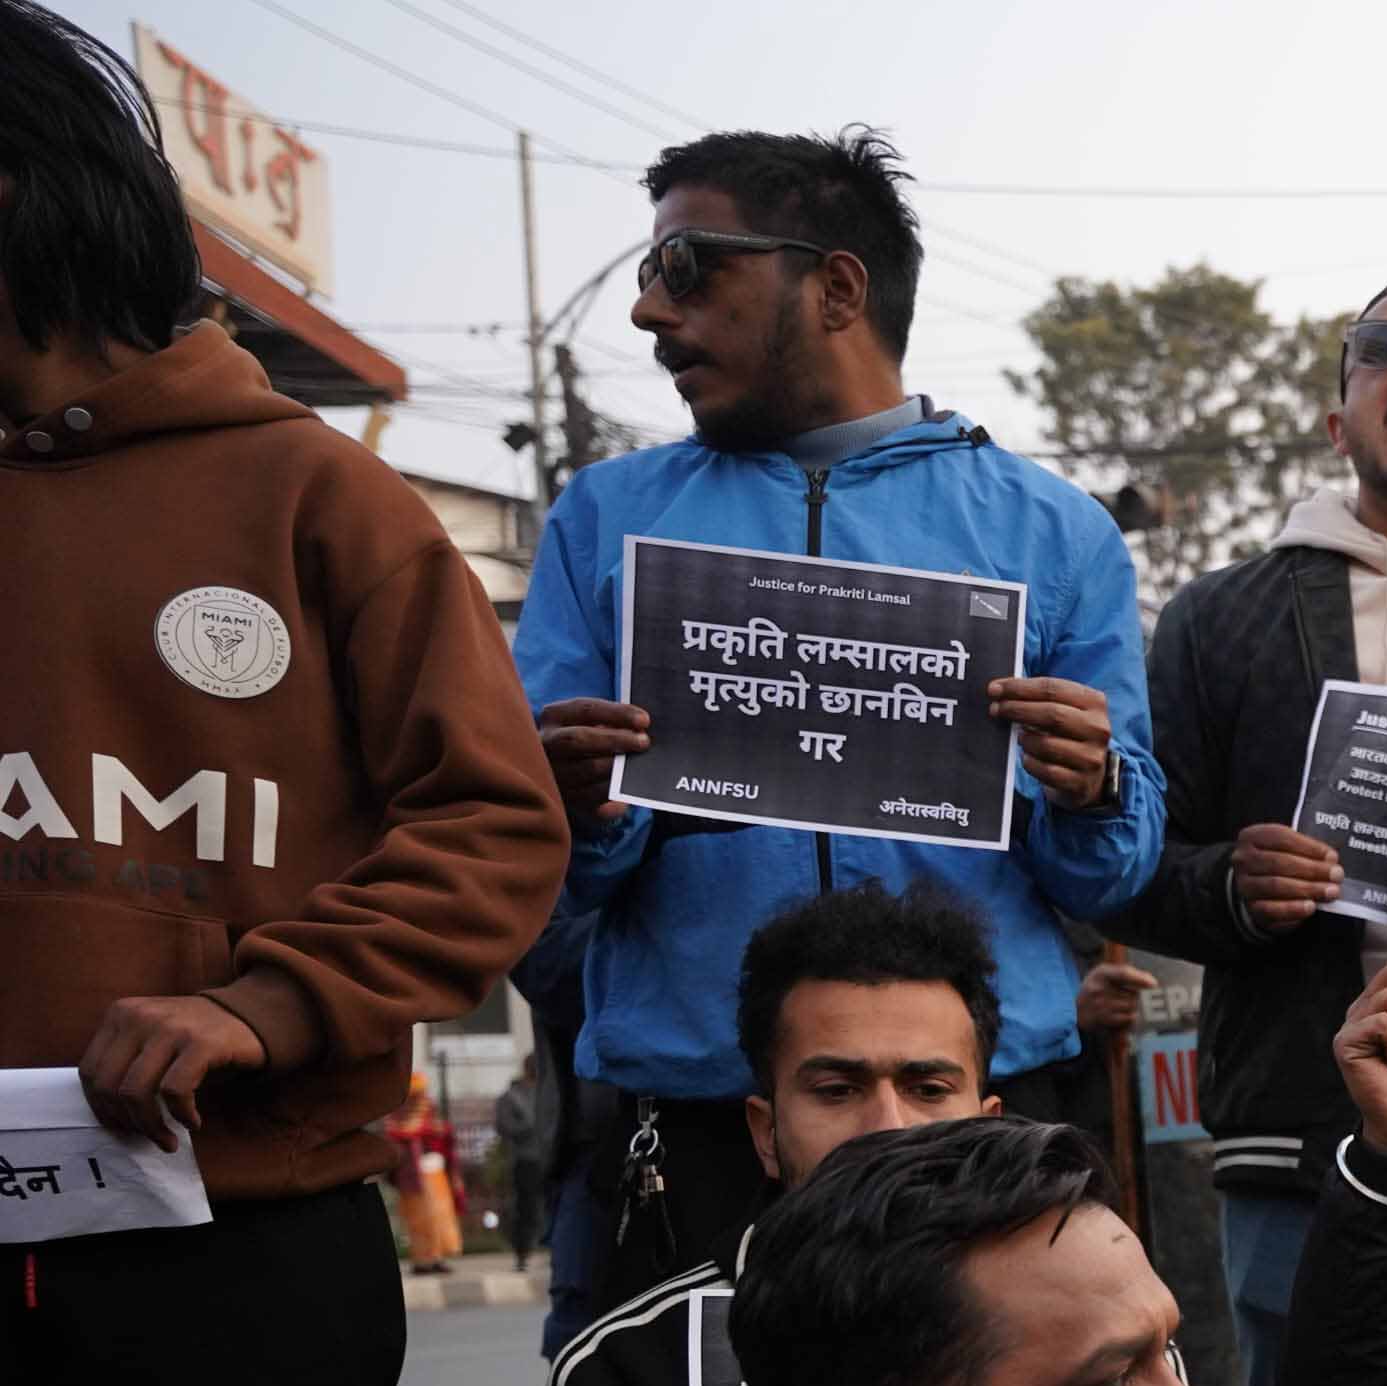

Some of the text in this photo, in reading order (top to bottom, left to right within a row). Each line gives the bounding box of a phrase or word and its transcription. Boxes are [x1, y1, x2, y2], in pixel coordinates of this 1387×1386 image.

[749, 576, 911, 605] Justice for Prakriti Lamsal
[202, 612, 253, 627] MIAMI
[681, 617, 971, 681] प्रकृति लम्सालको
[689, 669, 958, 726] मृत्युको छानबिन
[799, 730, 847, 763] गर
[675, 776, 760, 800] ANNFSU
[1337, 780, 1384, 801] Protect
